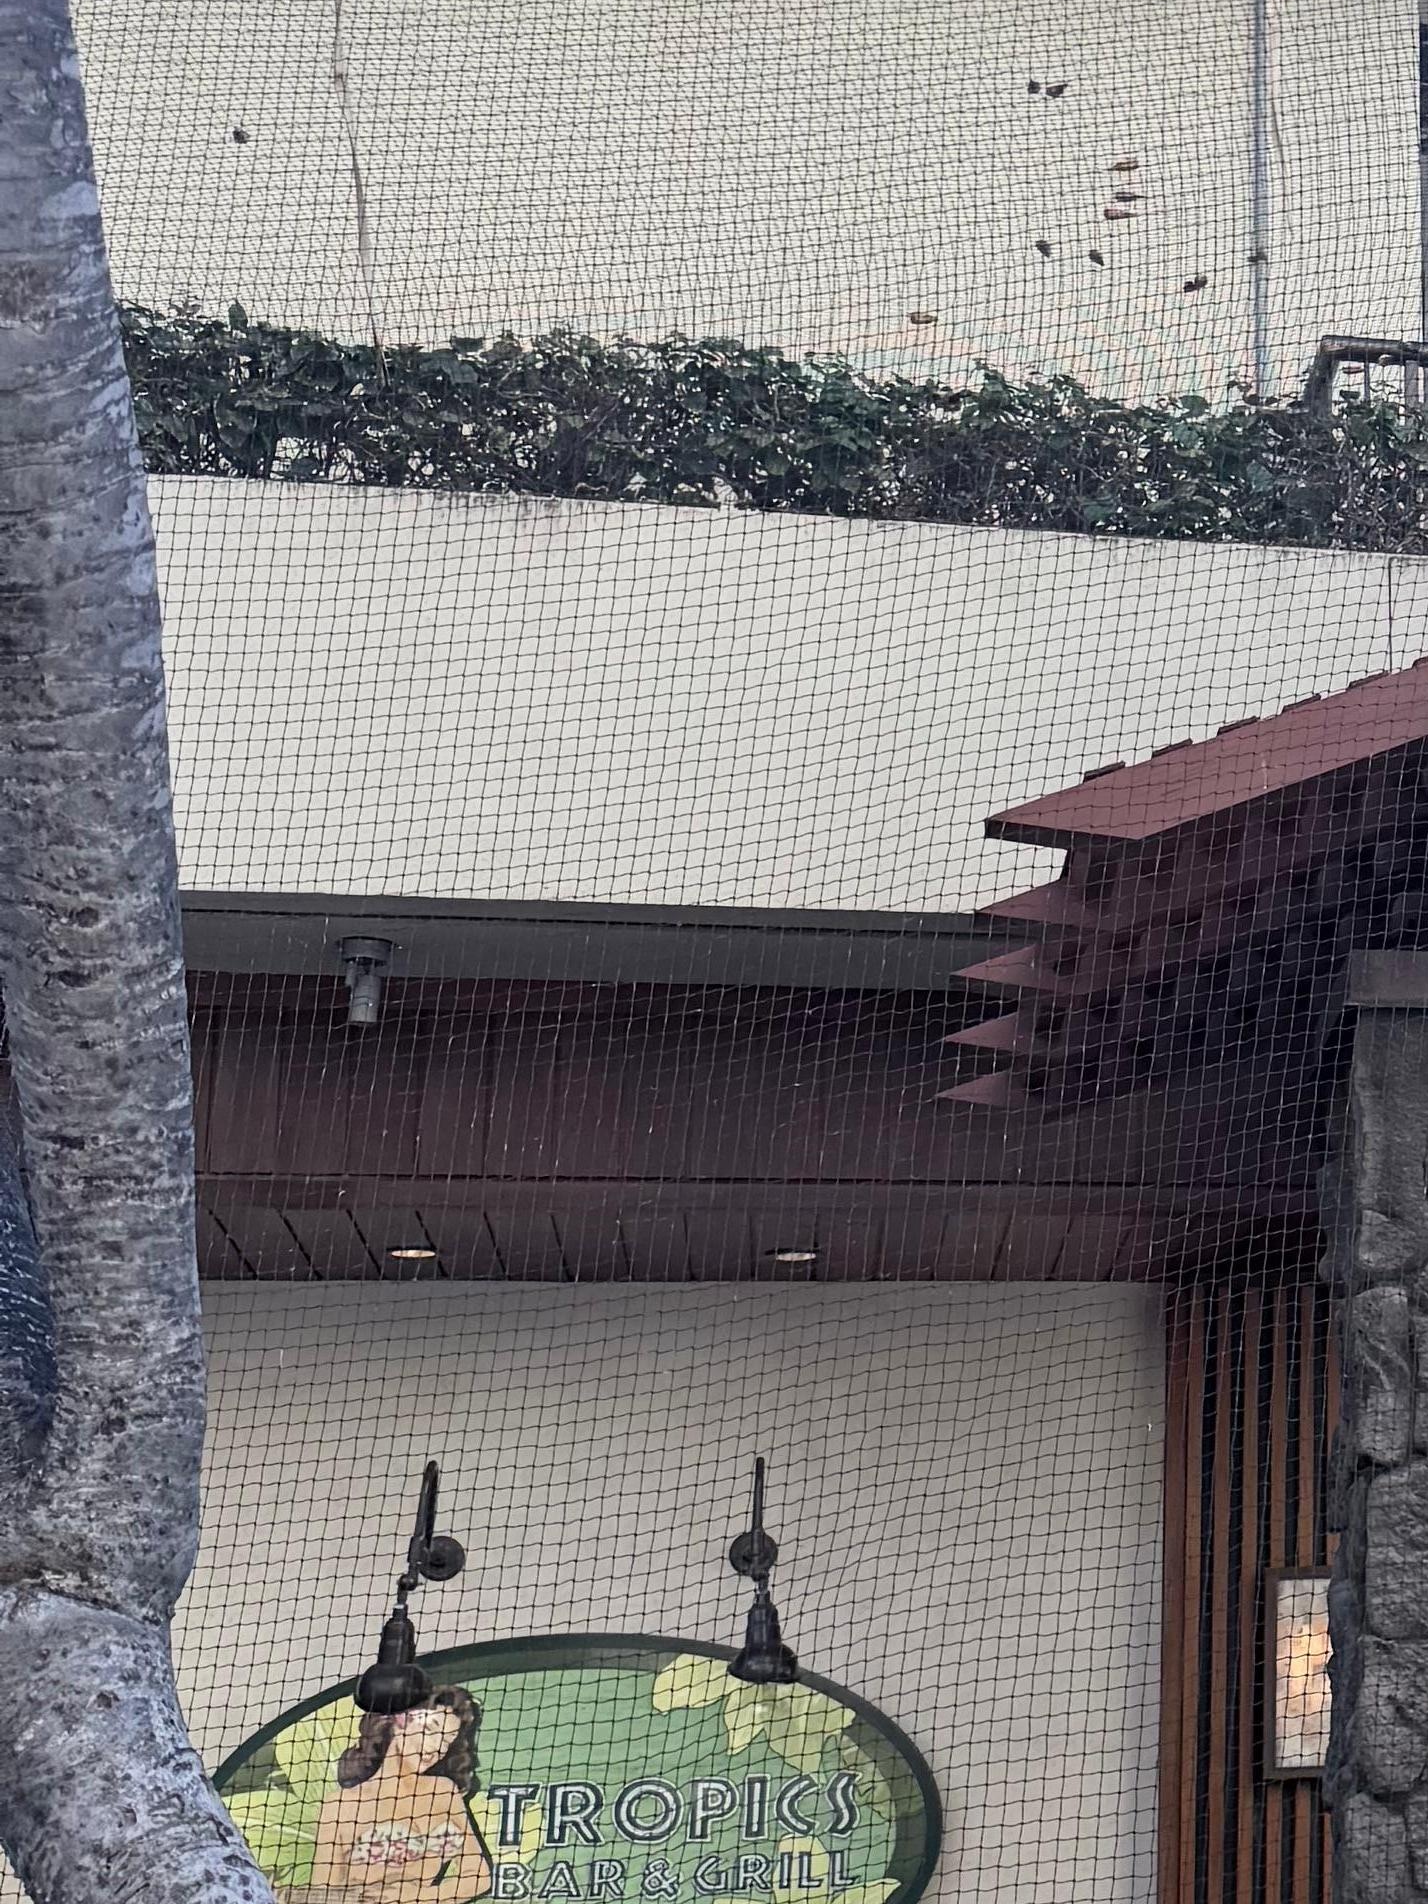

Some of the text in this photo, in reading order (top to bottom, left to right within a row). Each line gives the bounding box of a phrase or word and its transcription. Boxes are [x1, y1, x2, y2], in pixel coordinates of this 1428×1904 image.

[488, 1771, 861, 1848] TROPICS
[491, 1850, 862, 1902] BAR & GRILL
